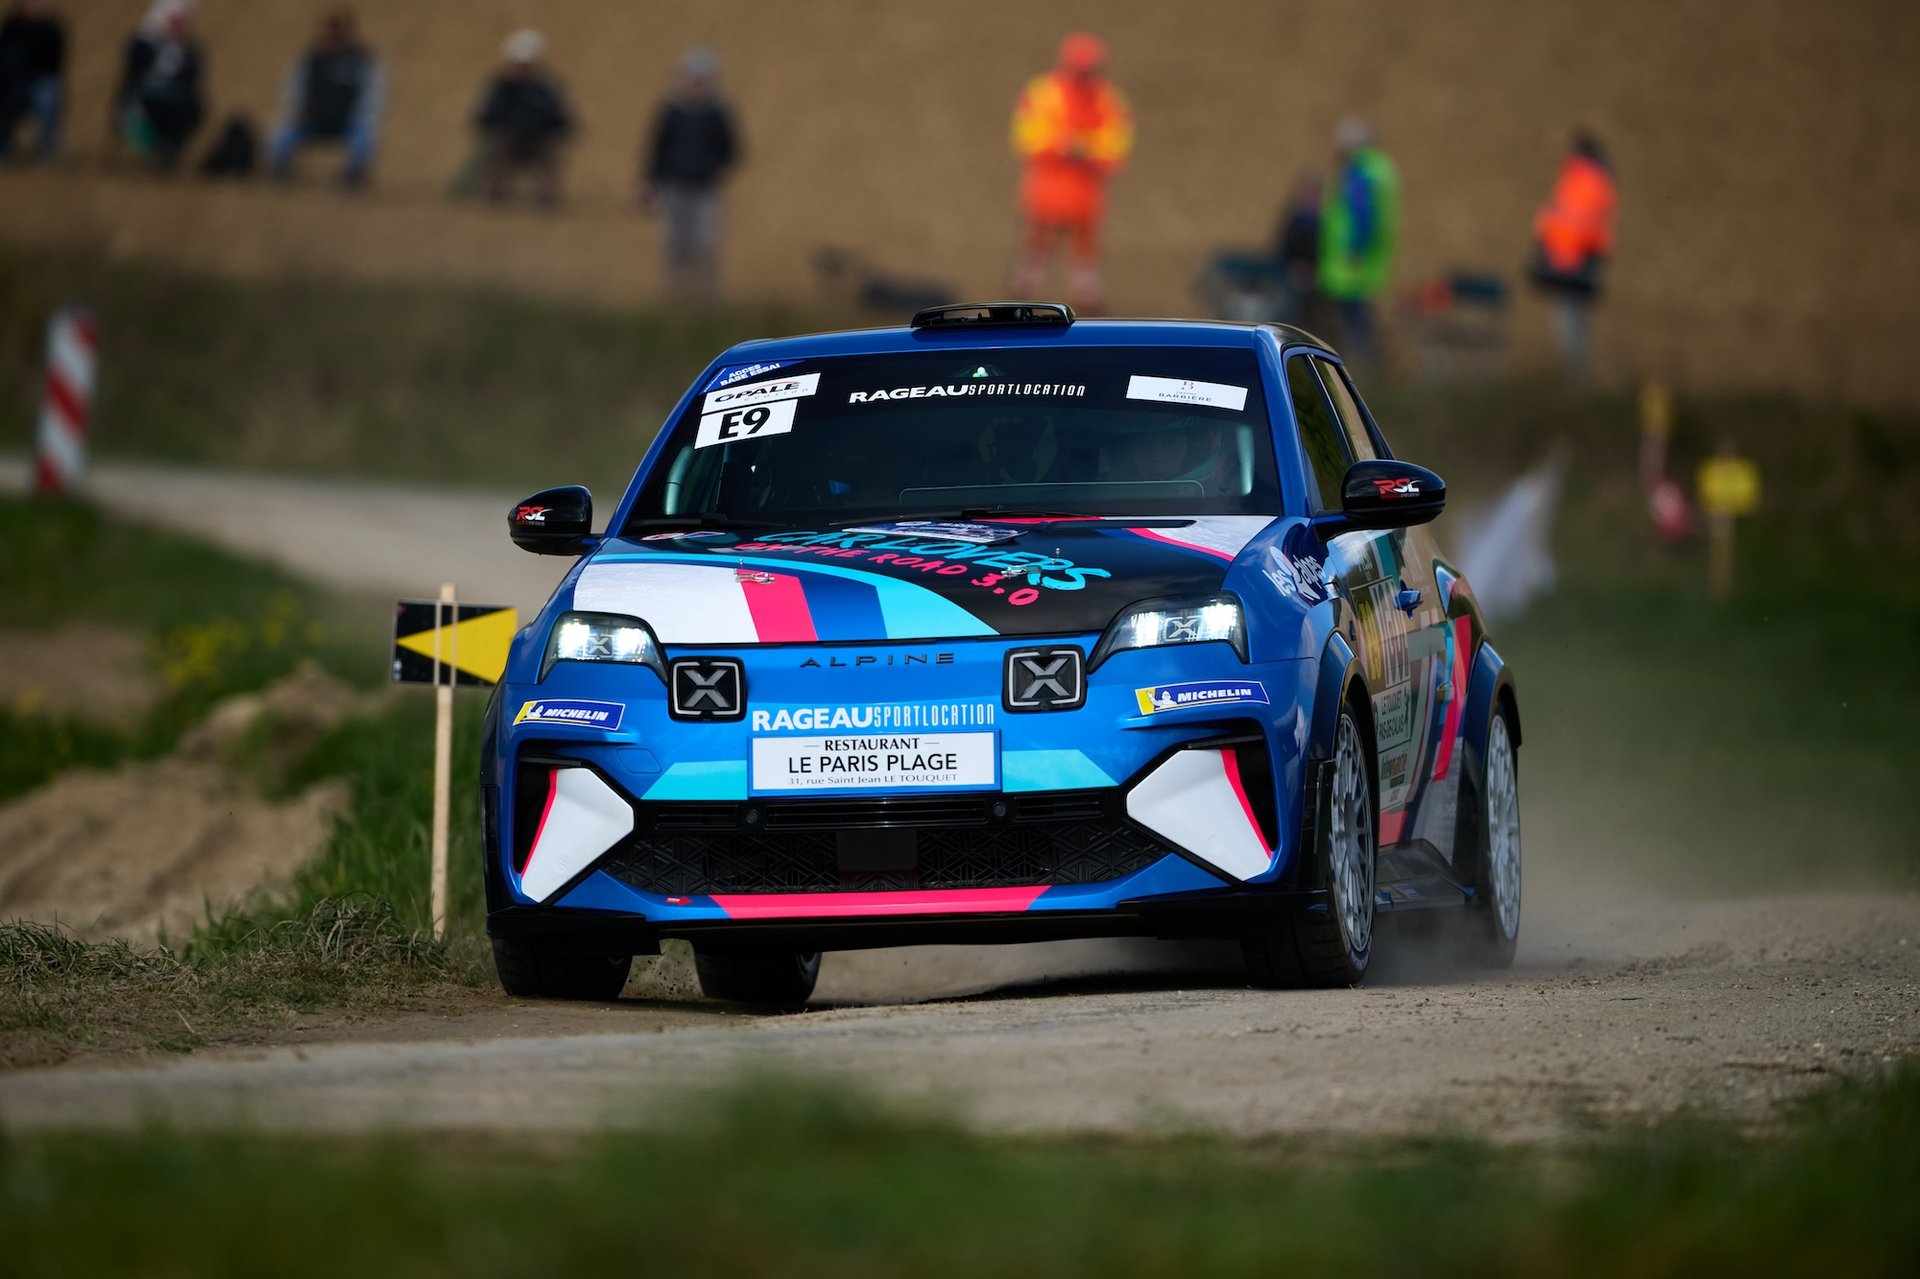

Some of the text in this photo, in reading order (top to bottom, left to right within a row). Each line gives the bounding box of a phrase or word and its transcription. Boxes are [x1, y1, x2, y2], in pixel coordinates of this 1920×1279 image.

[720, 363, 781, 387] BASE ESSAI
[714, 383, 800, 403] OPALE
[718, 407, 771, 440] E9
[753, 531, 1112, 591] CAR LOVERS
[795, 545, 870, 558] THE
[868, 553, 968, 575] ROAD
[971, 573, 1040, 606] 3.0
[1261, 569, 1296, 597] les
[800, 652, 955, 668] ALPINE
[1177, 688, 1252, 702] MICHELIN
[542, 708, 609, 721] MICHELIN
[824, 737, 920, 751] RESTAURANT
[789, 753, 958, 773] LE PARIS PLAGE
[788, 778, 803, 786] 31,
[827, 776, 854, 784] Saint
[856, 776, 881, 785] Jean
[884, 775, 896, 783] LE
[899, 774, 958, 783] TOUQUET
